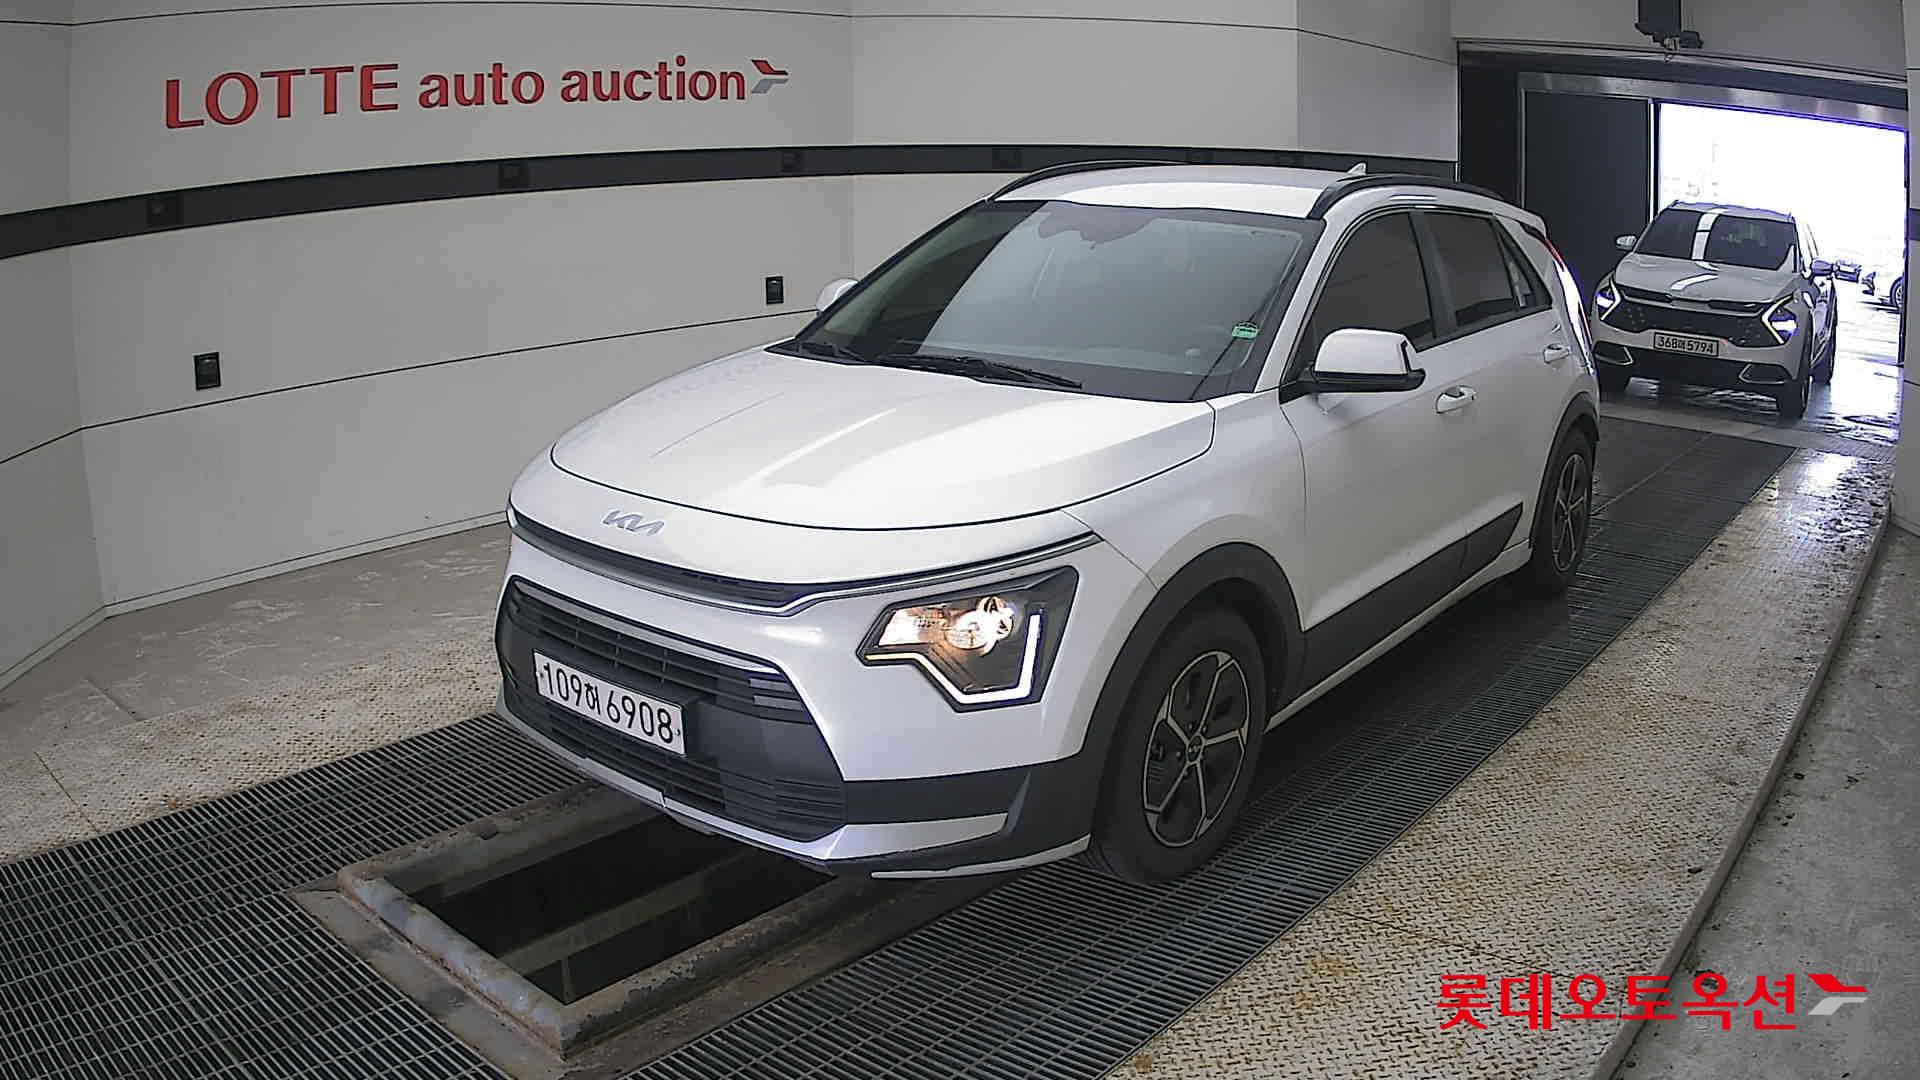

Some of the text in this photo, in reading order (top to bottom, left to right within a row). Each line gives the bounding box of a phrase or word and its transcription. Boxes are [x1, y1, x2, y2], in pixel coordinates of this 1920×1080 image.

[165, 55, 747, 129] LOTTE auto auction
[1687, 340, 1713, 354] 5794
[543, 661, 673, 744] 109허 6908
